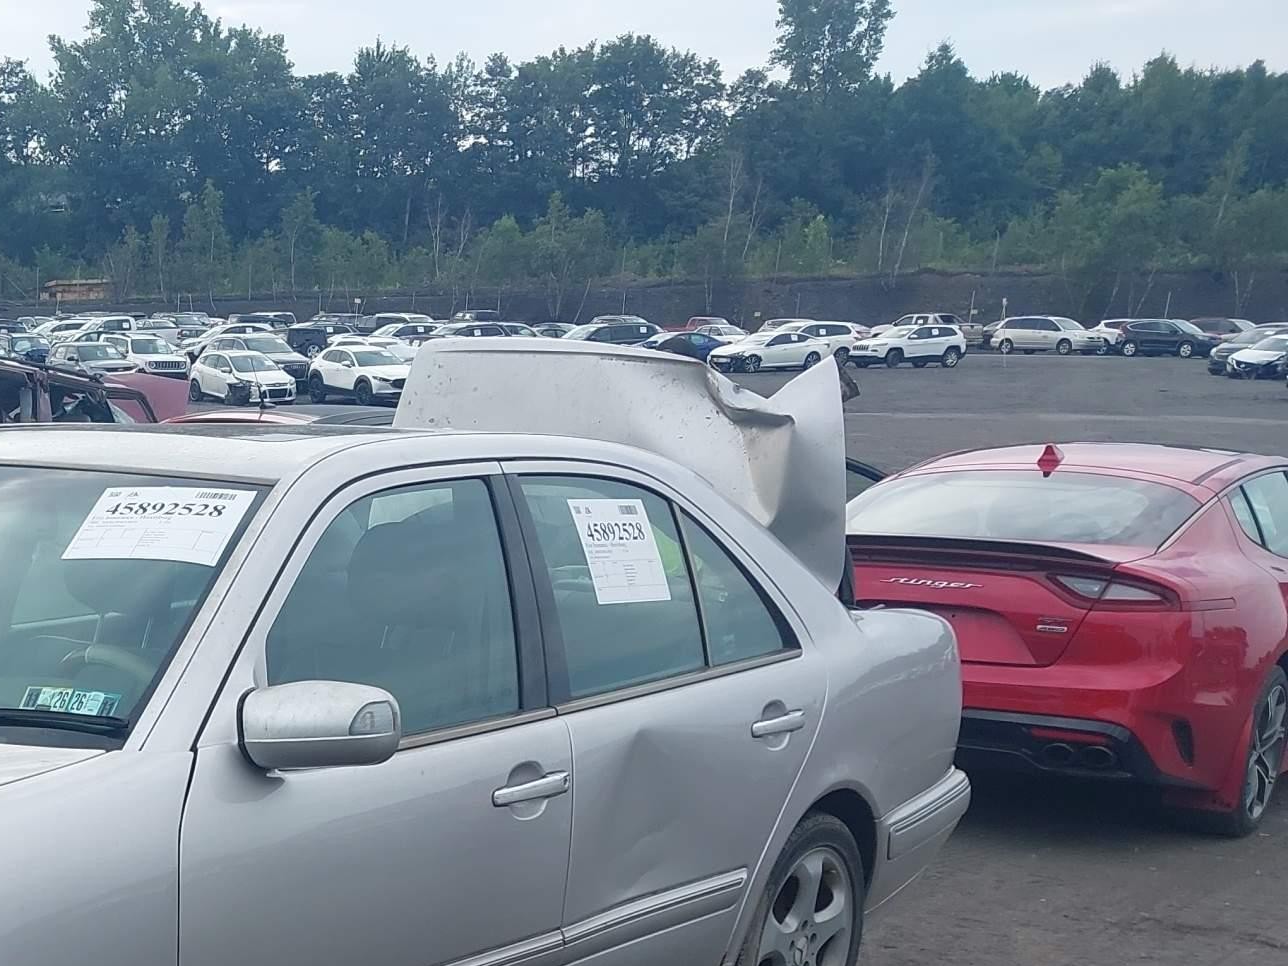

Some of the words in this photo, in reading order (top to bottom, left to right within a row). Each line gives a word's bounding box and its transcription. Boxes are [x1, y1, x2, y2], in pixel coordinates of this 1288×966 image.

[105, 501, 228, 518] 45892528
[587, 522, 646, 542] 45892528
[53, 691, 70, 709] 26
[70, 693, 87, 711] 26
